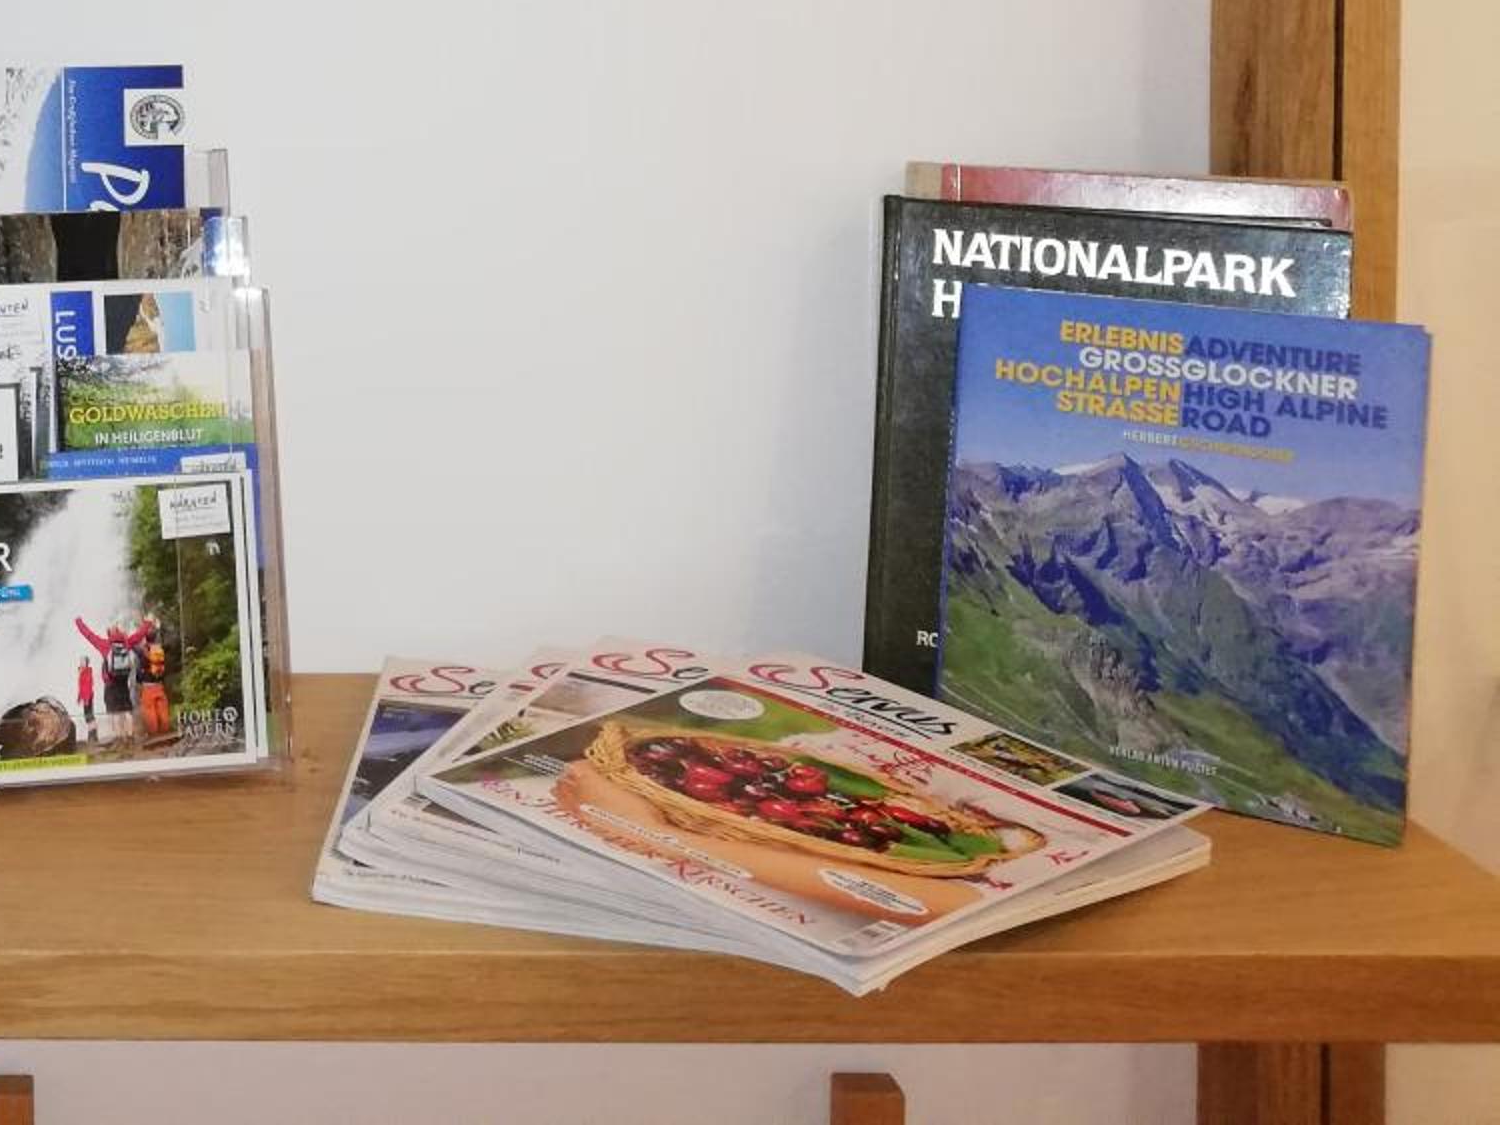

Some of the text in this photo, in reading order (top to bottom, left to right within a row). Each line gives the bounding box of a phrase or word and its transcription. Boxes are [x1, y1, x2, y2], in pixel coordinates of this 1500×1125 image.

[932, 227, 1297, 298] NATIONALPARK
[1059, 319, 1361, 375] ERLEBNIS ADVENTURE
[1078, 346, 1358, 401] GROSSGLOCKNER
[995, 358, 1389, 430] HOCHALPEN HIGH ALPINE
[1055, 389, 1272, 439] STRASSE ROAD
[94, 428, 204, 445] IN HEILIGENBLUT
[177, 709, 222, 724] HOHE
[748, 663, 958, 737] Servus
